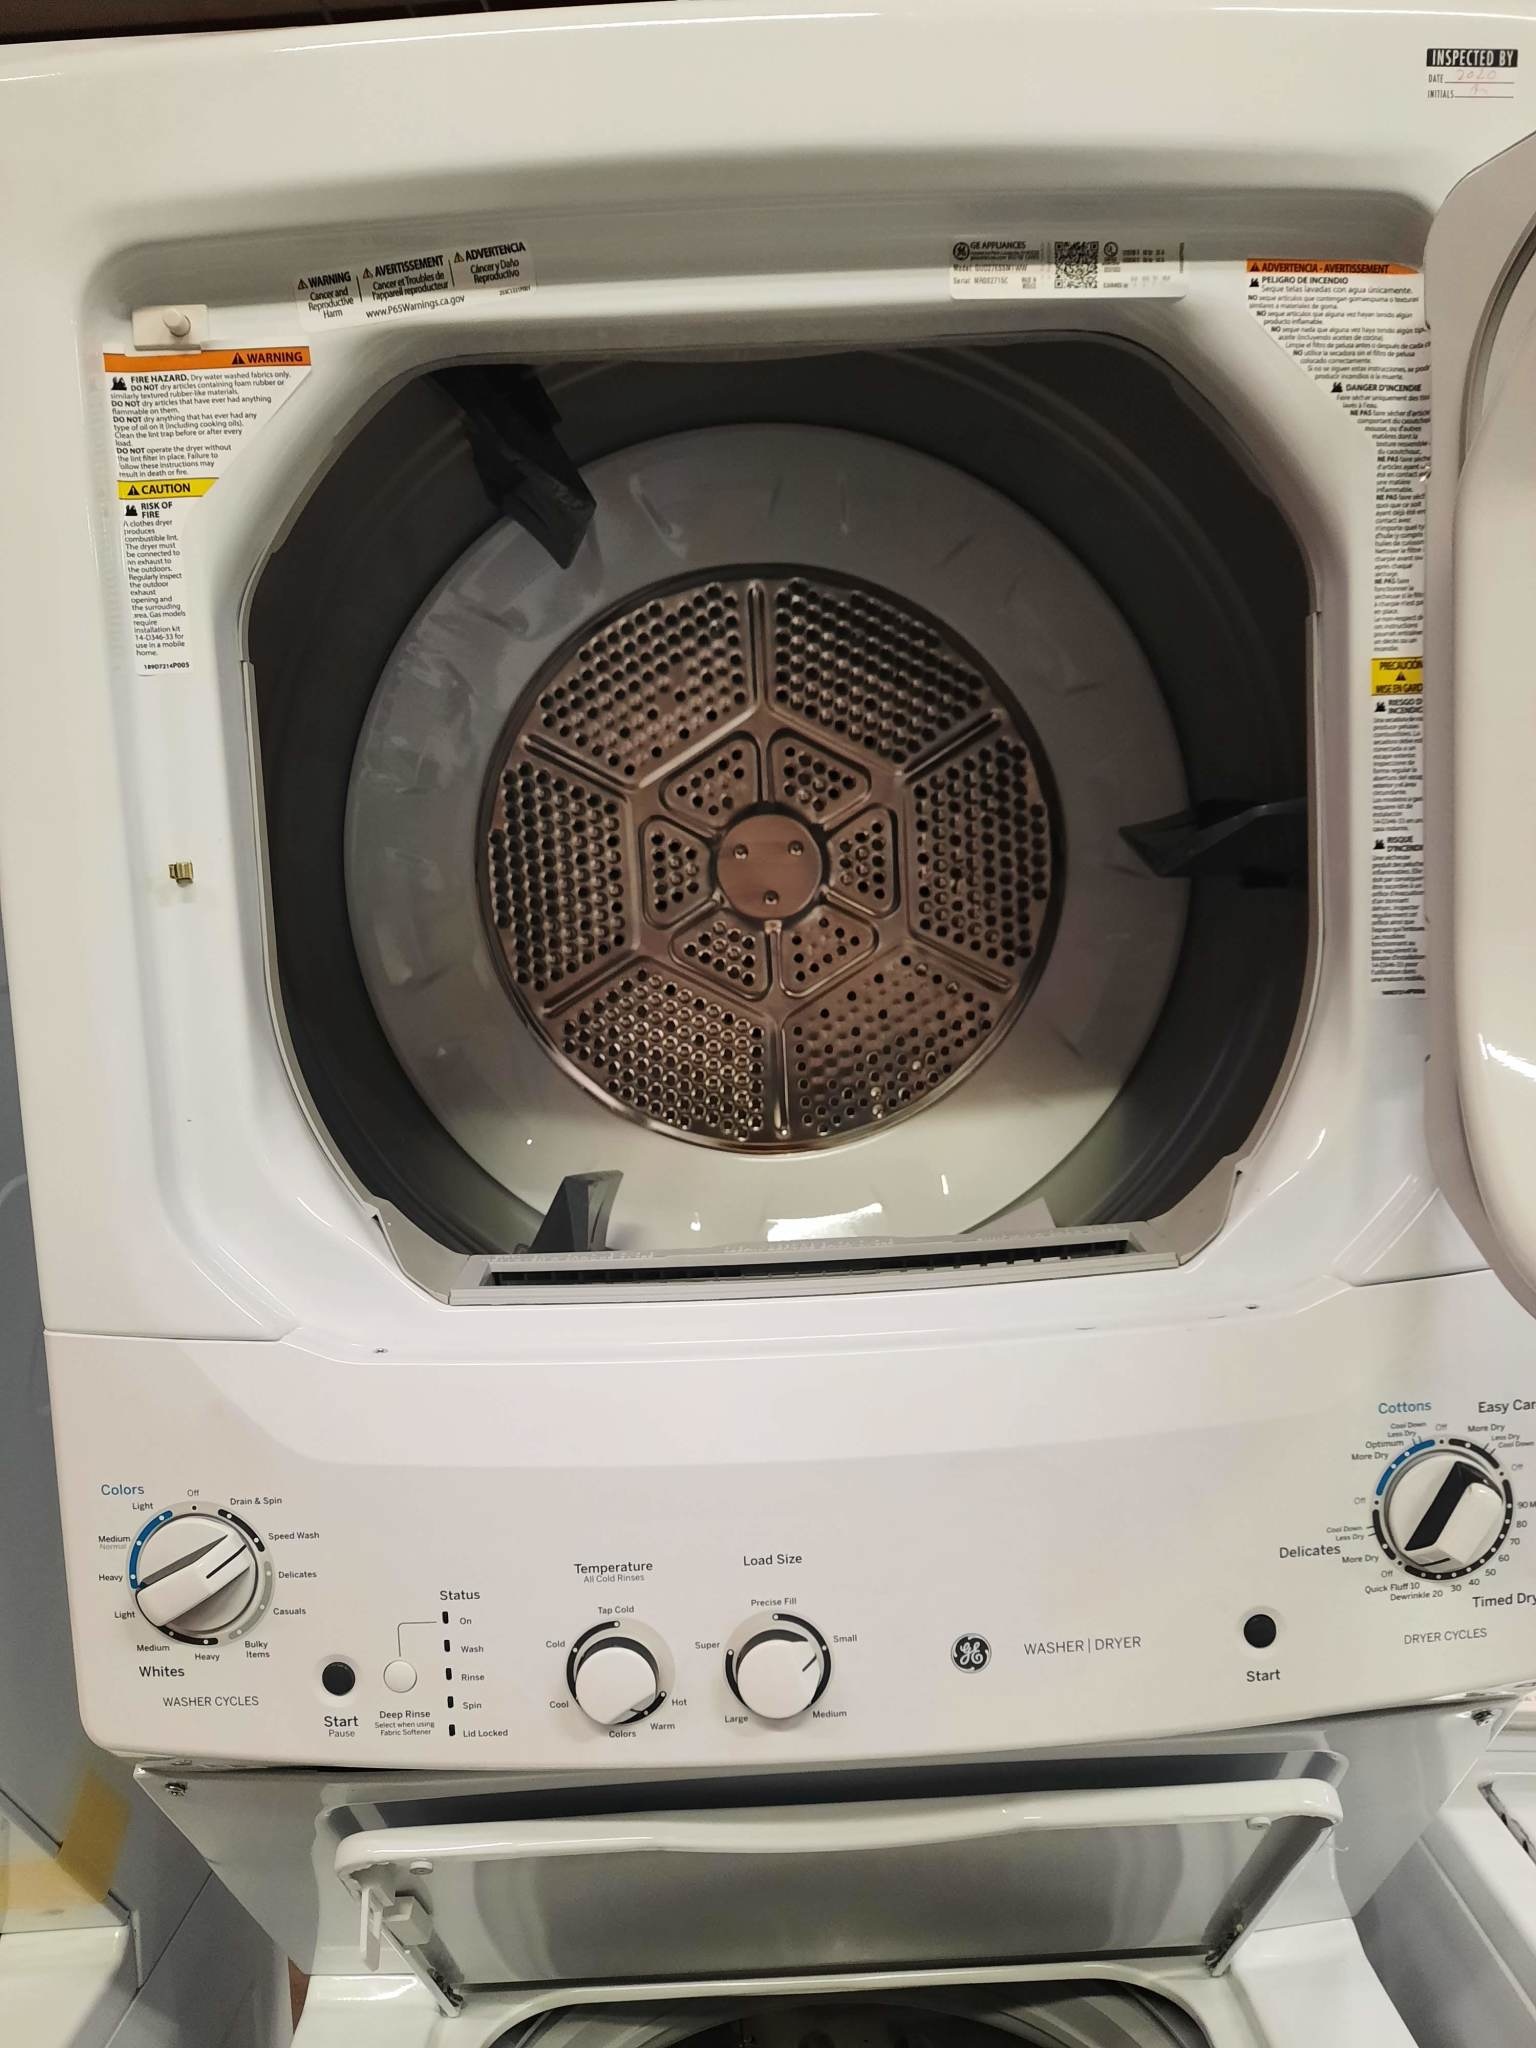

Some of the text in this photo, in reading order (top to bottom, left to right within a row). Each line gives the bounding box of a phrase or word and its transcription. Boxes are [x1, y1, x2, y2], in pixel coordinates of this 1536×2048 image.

[1432, 49, 1514, 66] INSPECTED BY
[1428, 74, 1444, 83] DATE
[1427, 90, 1454, 98] INITIALS
[982, 240, 1026, 249] APPLIANCES
[465, 242, 526, 260] ADVERTENCIA
[375, 255, 444, 276] AVERTISSEMENT
[1262, 262, 1390, 274] ADVERTENCIA AVERTISSEMENT
[308, 272, 351, 288] WARNING
[372, 271, 445, 290] Cancer et Troubles de
[474, 269, 520, 284] Reproductivo
[1262, 276, 1348, 284] PELIGRO DE INCENDIO
[309, 286, 349, 301] Cancer and
[404, 280, 448, 297] reproducteur
[308, 297, 354, 312] Reproductive
[366, 294, 465, 318] www.P65Warnings.ca.gov
[323, 308, 343, 319] Harm
[246, 352, 303, 364] WARNING
[130, 376, 149, 384] FIRE
[151, 374, 190, 382] HAZARD.
[190, 374, 202, 382] Dry
[274, 370, 292, 379] only.
[130, 384, 142, 392] DO
[198, 382, 232, 390] containing
[141, 482, 190, 495] CAUTION
[141, 502, 160, 510] RISK
[1378, 1400, 1432, 1414] Cottons
[1478, 1399, 1536, 1414] Easy Car
[1468, 1424, 1505, 1432] More Dry
[1365, 1439, 1404, 1449] Optimum
[1352, 1452, 1389, 1460] More Dry
[100, 1484, 145, 1496] Colors
[186, 1489, 200, 1497] Off
[230, 1497, 253, 1506] Drain
[262, 1496, 282, 1506] Spin
[1354, 1496, 1366, 1504] Off
[1518, 1500, 1528, 1508] 90
[132, 1502, 154, 1511] Light
[1516, 1520, 1528, 1528] 80
[98, 1535, 130, 1543] Medium
[268, 1532, 320, 1542] Speed Wash
[1280, 1544, 1341, 1558] Delicates
[744, 1554, 802, 1566] Load Size
[1342, 1554, 1379, 1564] More Dry
[1498, 1554, 1510, 1562] 60
[574, 1560, 653, 1574] Temperature
[1485, 1568, 1496, 1576] 50
[98, 1574, 123, 1582] Heavy
[278, 1570, 317, 1579] Delicates
[596, 1575, 616, 1583] Cold
[616, 1574, 645, 1582] Rinses
[1380, 1570, 1393, 1578] Off
[1468, 1578, 1480, 1586] 40
[1364, 1582, 1420, 1594] Quick Fluff 10
[1450, 1584, 1462, 1592] 30
[440, 1590, 480, 1601] Status
[1390, 1590, 1443, 1601] Dewrinkle 20
[1472, 1592, 1536, 1608] Timed Dry
[751, 1597, 798, 1607] Precise Fill
[272, 1607, 306, 1616] Casuals
[598, 1604, 635, 1615] Tap Cold
[114, 1610, 136, 1620] Light
[460, 1617, 472, 1625] On
[833, 1634, 858, 1643] Small
[1404, 1628, 1487, 1644] DRYER CYCLES
[136, 1644, 170, 1652] Medium
[244, 1640, 268, 1650] Bulky
[460, 1645, 484, 1653] Wash
[546, 1640, 566, 1648] Cold
[694, 1641, 721, 1652] Super
[1024, 1635, 1142, 1656] WASHER DRYER
[194, 1653, 220, 1662] Heavy
[246, 1650, 270, 1659] Items
[138, 1666, 184, 1678] Whites
[461, 1673, 484, 1681] Rinse
[1246, 1668, 1281, 1683] Start
[162, 1696, 258, 1708] WASHER CYCLES
[462, 1702, 482, 1710] Spin
[550, 1700, 569, 1709] Cool
[672, 1698, 688, 1706] Hot
[379, 1709, 431, 1720] Deep Rinse
[812, 1709, 848, 1718] Medium
[324, 1716, 359, 1728] Start
[724, 1714, 749, 1724] Large
[416, 1720, 435, 1729] using
[650, 1722, 676, 1731] Warm
[328, 1729, 356, 1738] Pause
[463, 1728, 509, 1738] Lid Locked
[609, 1729, 637, 1738] Colors
